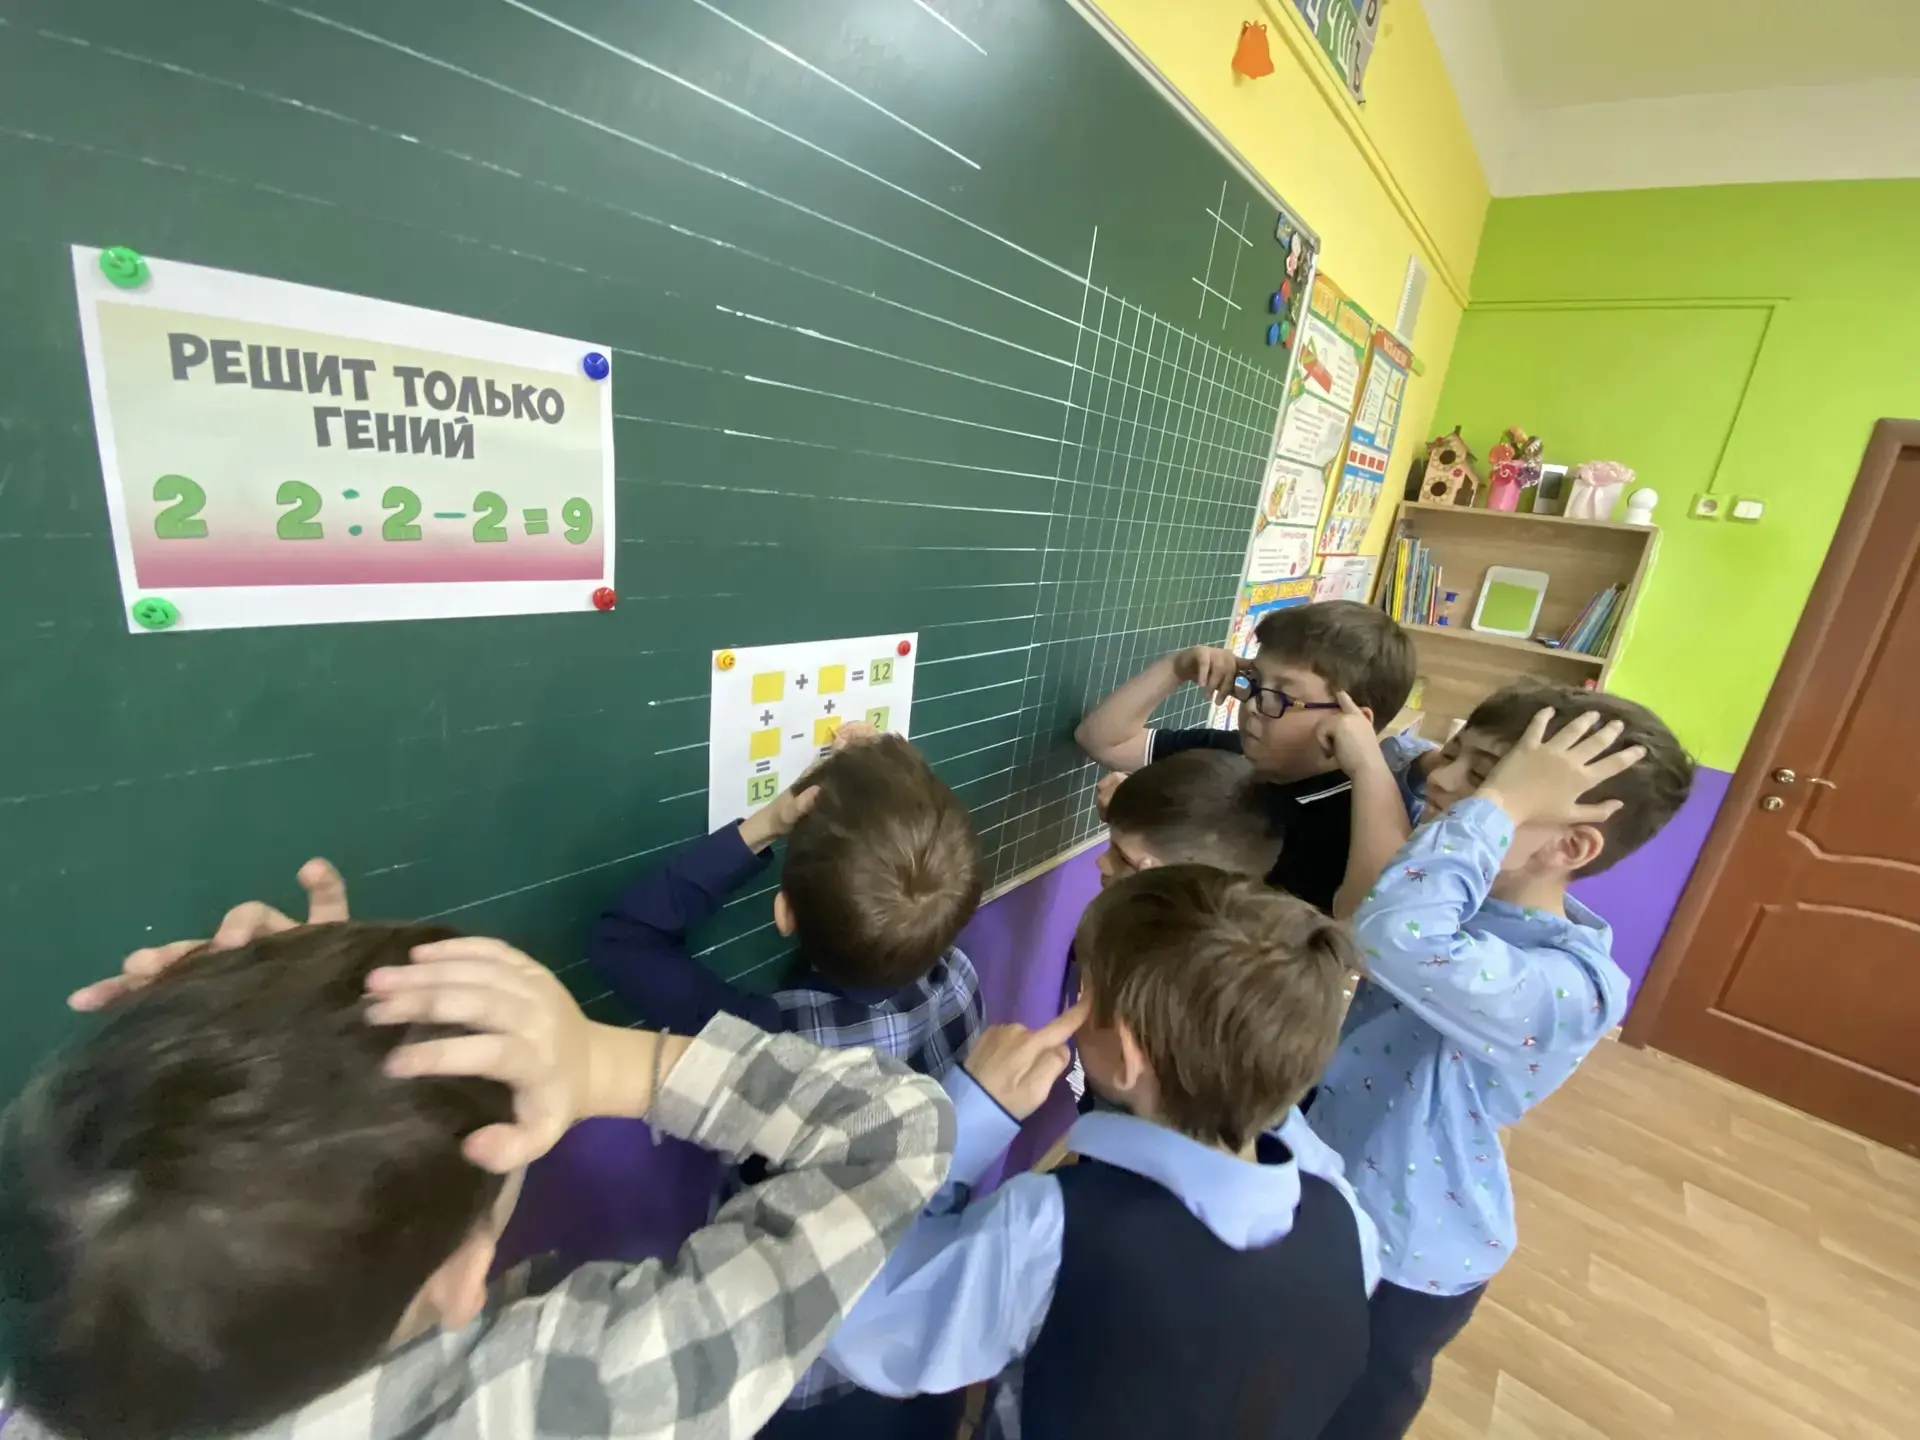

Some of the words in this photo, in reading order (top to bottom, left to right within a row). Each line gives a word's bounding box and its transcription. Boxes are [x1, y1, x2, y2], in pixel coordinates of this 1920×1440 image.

[167, 332, 376, 401] РЕШИТ
[393, 365, 564, 425] ТОЛЬКО
[312, 406, 475, 460] ГЕНИЙ
[873, 663, 891, 682] 12
[752, 778, 774, 801] 15
